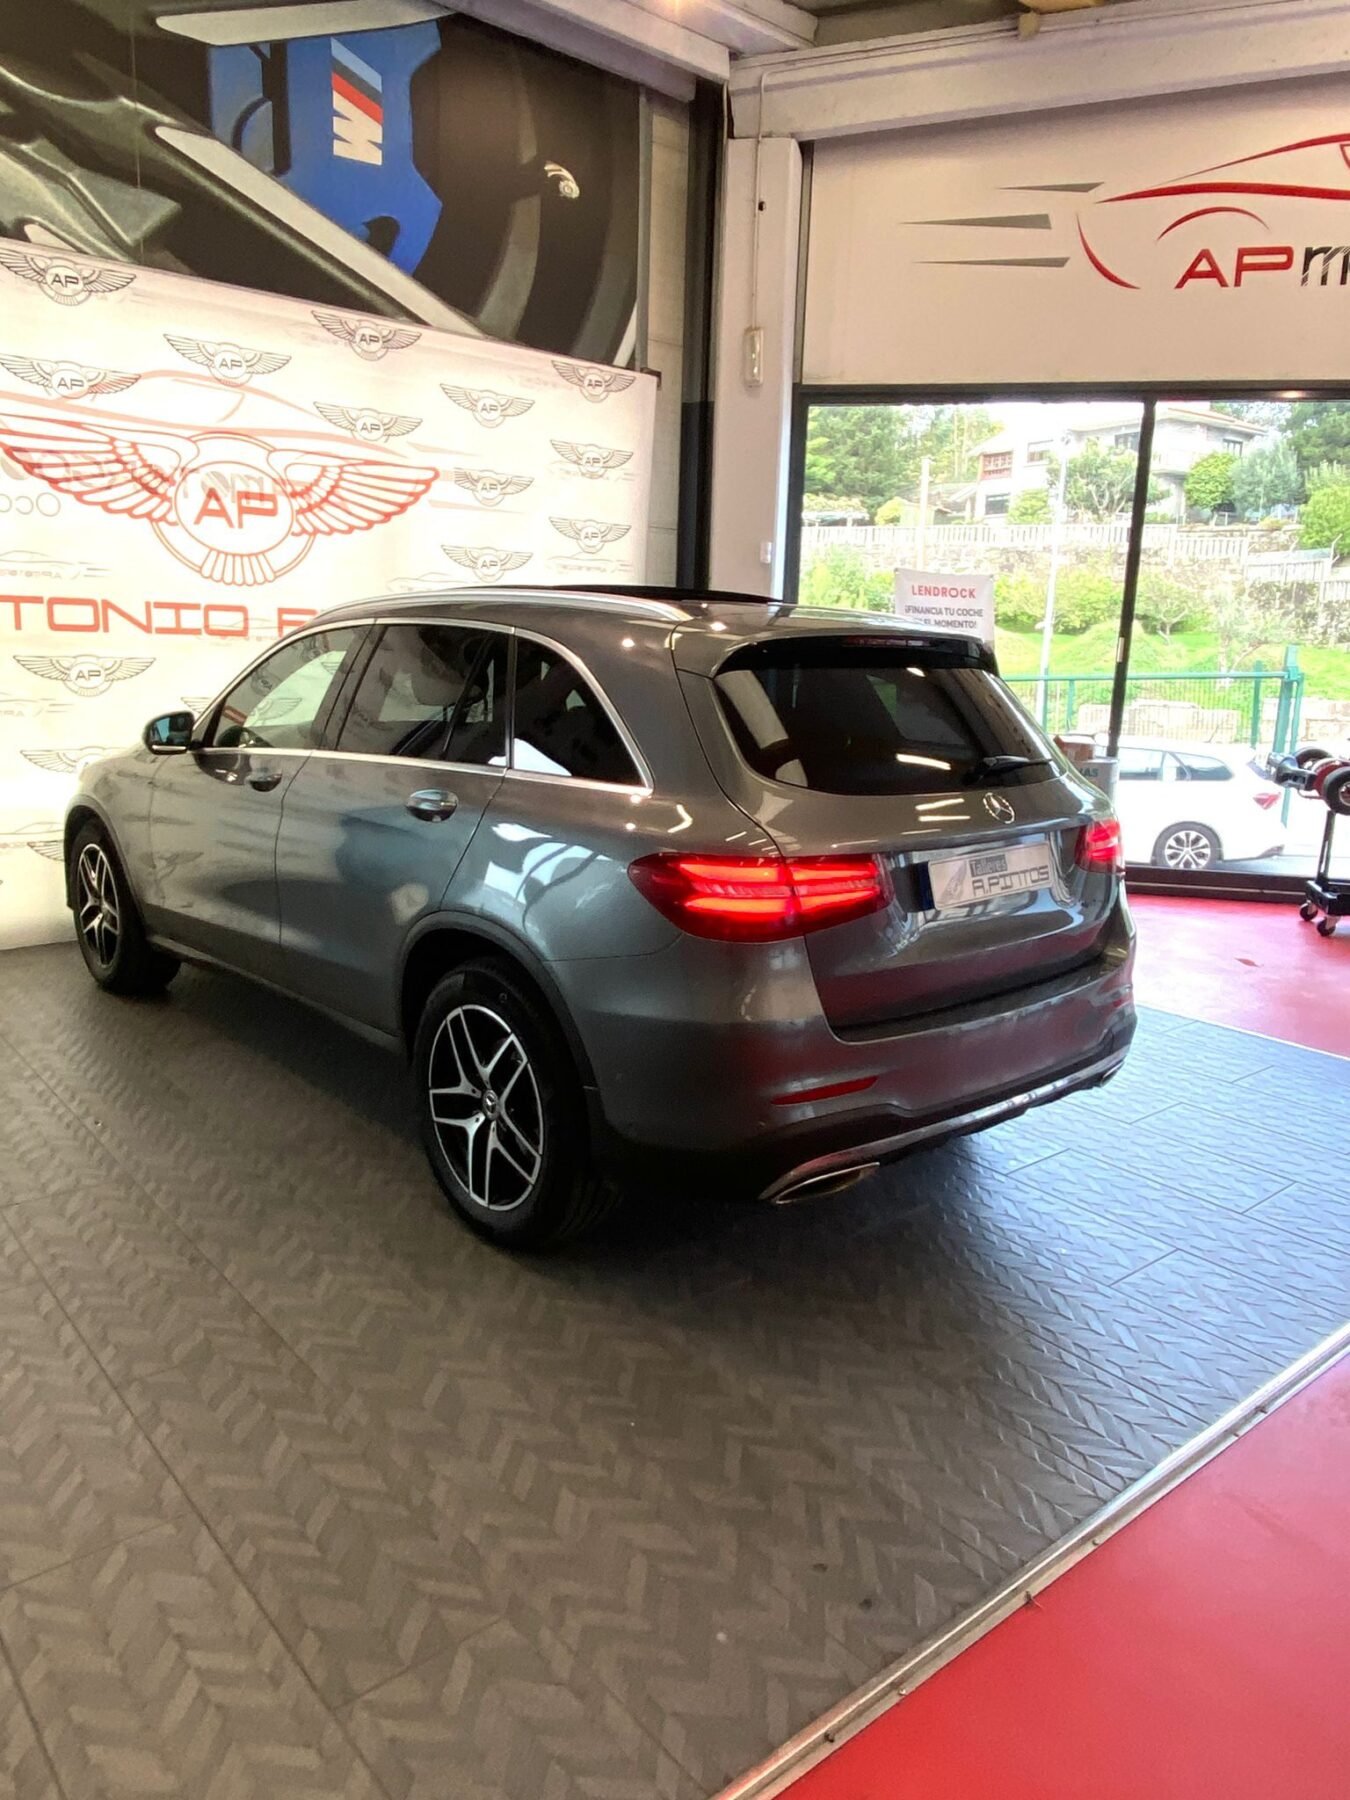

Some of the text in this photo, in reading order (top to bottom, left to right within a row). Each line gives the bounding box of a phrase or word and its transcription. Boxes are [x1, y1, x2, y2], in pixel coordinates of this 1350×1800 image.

[1174, 245, 1350, 289] APm
[51, 274, 79, 287] AP
[359, 333, 383, 345] AP
[219, 358, 243, 370] AP
[57, 377, 84, 390] AP
[586, 378, 603, 388] AP
[480, 403, 499, 413] AP
[360, 422, 382, 433] AP
[584, 456, 601, 467] AP
[480, 482, 498, 492] AP
[193, 487, 278, 529] AP
[583, 531, 601, 542] AP
[480, 559, 498, 569] AP
[911, 584, 976, 599] LENDROCK
[944, 606, 955, 616] TU
[956, 607, 984, 617] COCHE
[934, 618, 977, 629] MOMENTO!
[74, 669, 101, 680] AP
[970, 856, 1007, 876] Talleres
